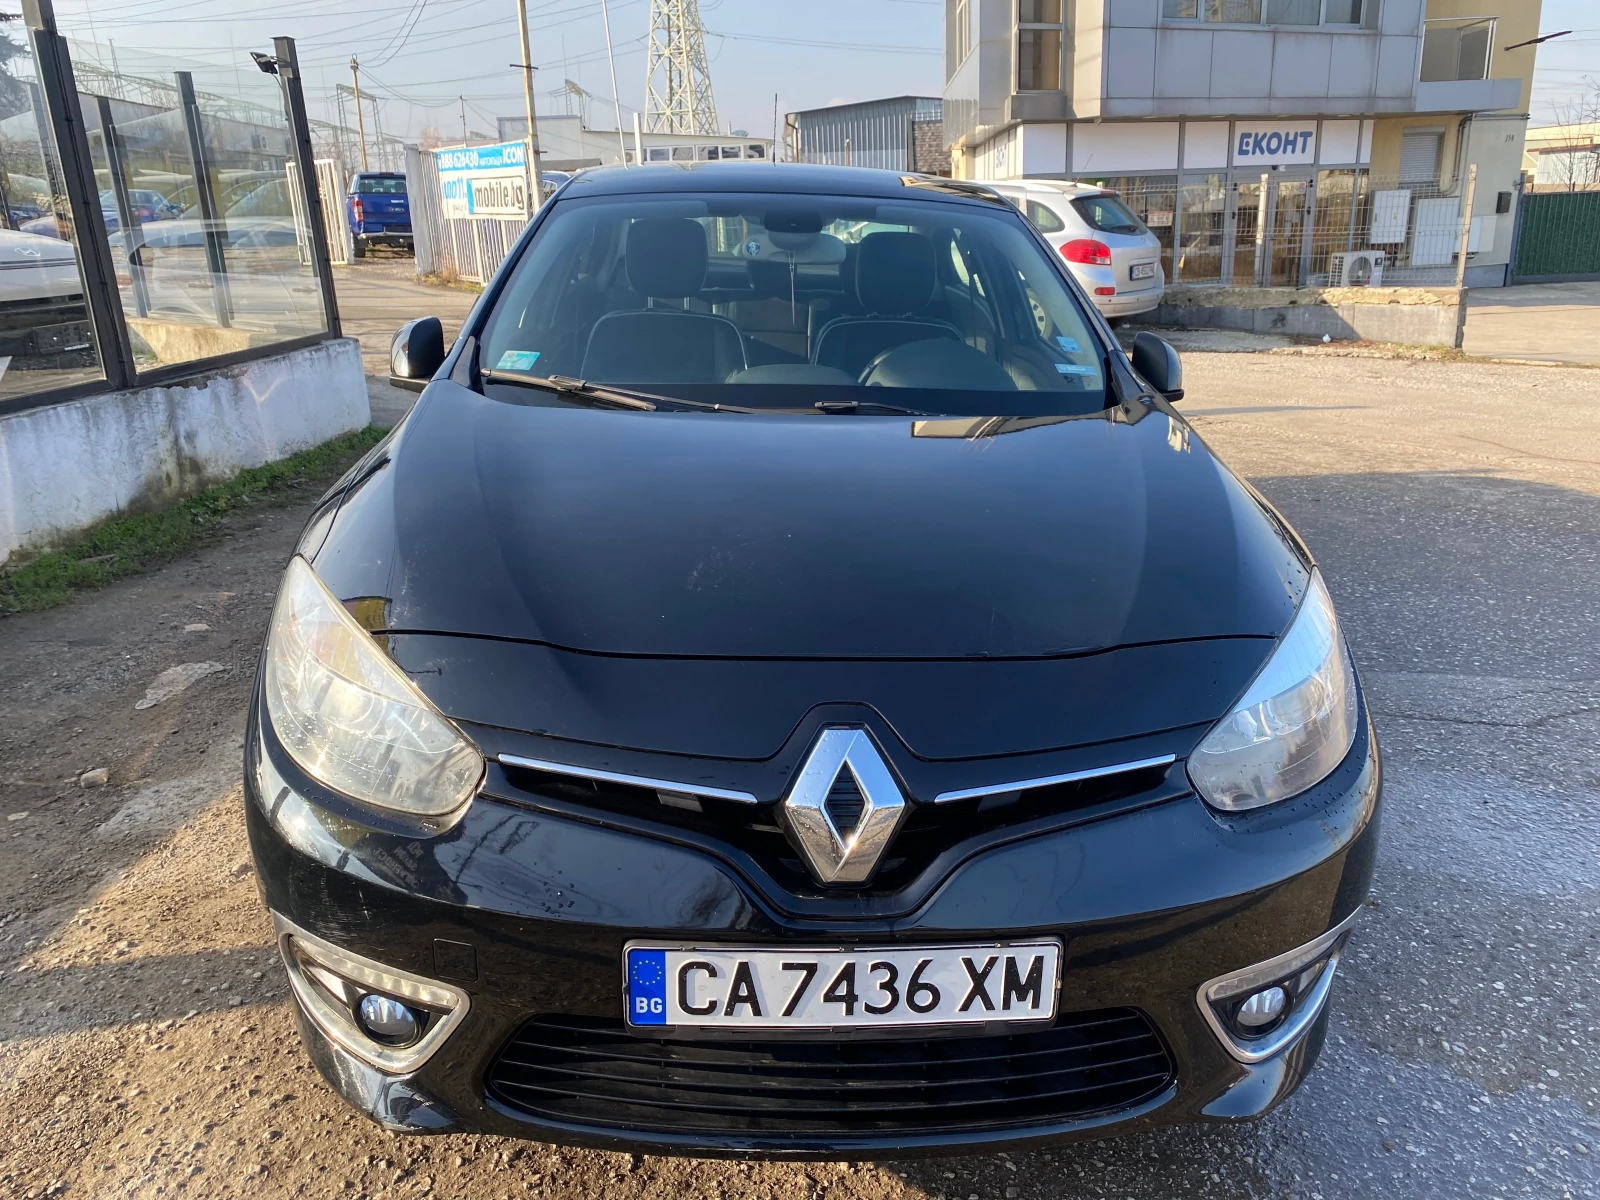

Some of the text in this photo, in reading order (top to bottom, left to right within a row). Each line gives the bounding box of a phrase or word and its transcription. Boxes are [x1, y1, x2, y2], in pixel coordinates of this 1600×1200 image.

[502, 146, 523, 164] ICON
[1237, 131, 1313, 156] ЕКОНТ
[474, 180, 525, 211] mobile.bg
[676, 954, 1044, 1017] CA 7436 XM
[635, 996, 663, 1014] BG
